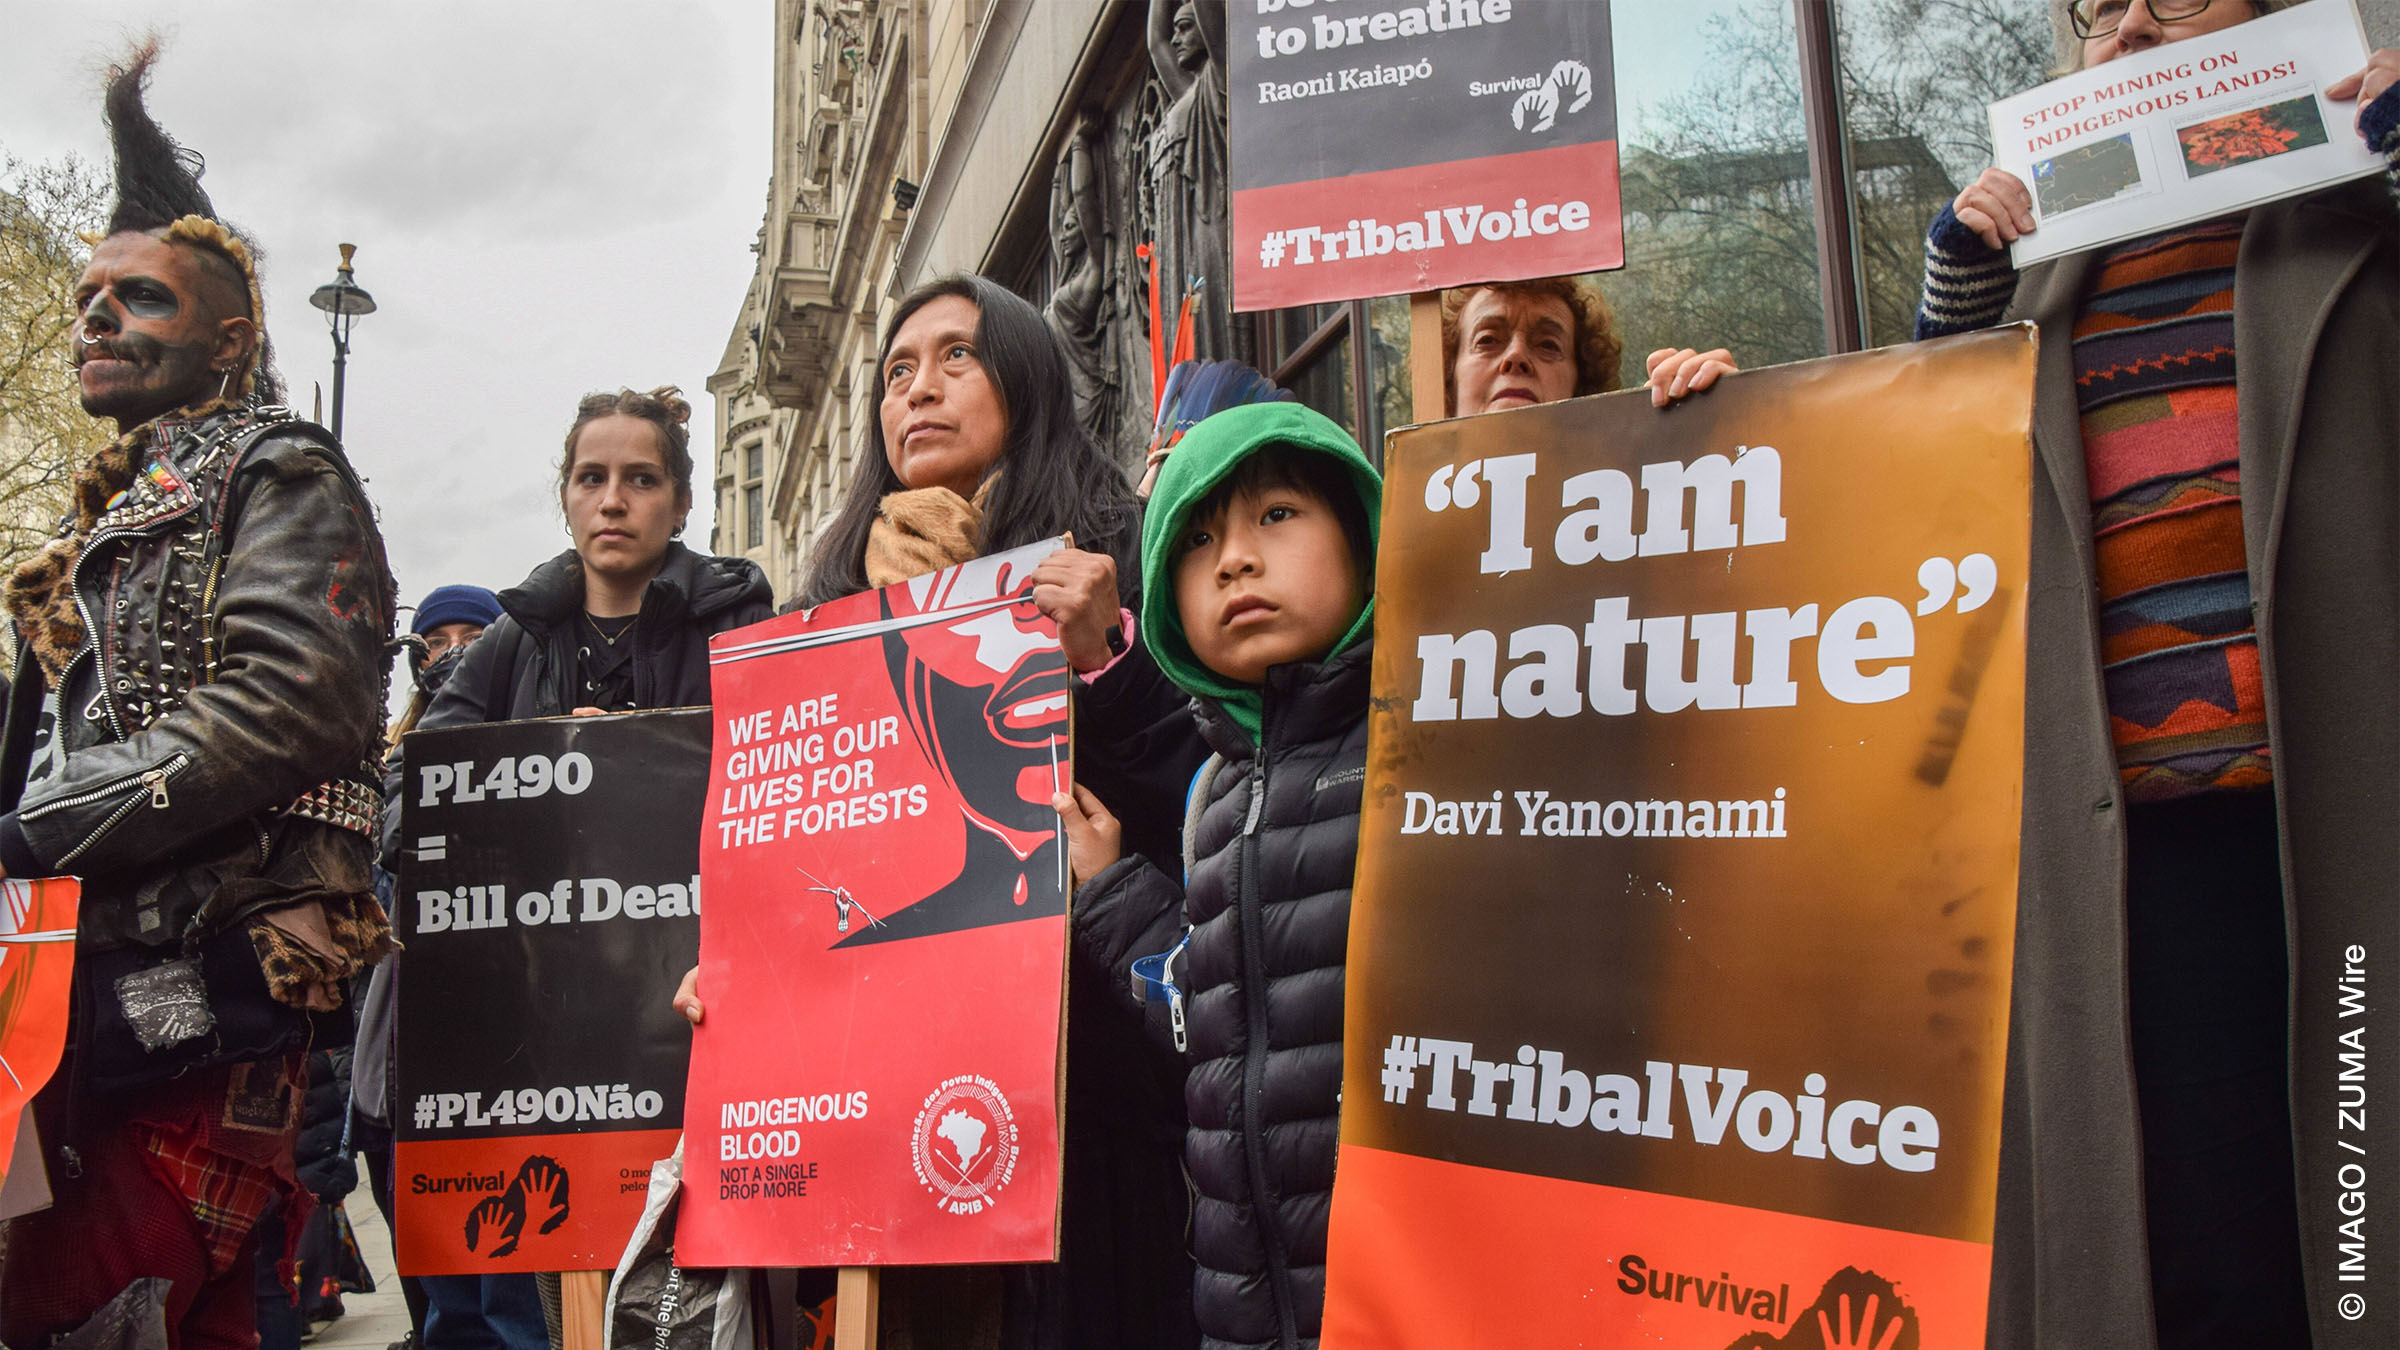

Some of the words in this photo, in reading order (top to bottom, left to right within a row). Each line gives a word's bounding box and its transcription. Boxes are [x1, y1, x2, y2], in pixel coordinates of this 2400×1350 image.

[1257, 26, 1306, 58] to
[1312, 0, 1511, 50] breathe
[1258, 72, 1334, 104] Raoni
[1338, 57, 1433, 92] Kaiapó
[1469, 73, 1542, 97] Survival
[2022, 95, 2086, 130] STOP
[2094, 63, 2192, 105] MINING
[2199, 50, 2240, 72] ON
[2027, 90, 2189, 153] INDIGENOUS
[2196, 60, 2297, 99] LANDS!
[1260, 198, 1590, 268] #TribalVoice
[1554, 445, 1787, 566] am
[1412, 553, 1998, 722] nature”
[728, 710, 772, 747] WE
[778, 693, 838, 736] ARE
[726, 733, 824, 781] GIVING
[833, 715, 899, 758] OUR
[419, 751, 593, 807] PL490
[721, 773, 804, 816] LIVES
[811, 758, 874, 799] FOR
[718, 812, 776, 850] THE
[783, 783, 928, 839] FORESTS
[1400, 790, 1503, 836] Davi
[1514, 787, 1788, 839] Yanomami
[417, 835, 446, 861] =
[416, 884, 508, 934] Bill
[516, 879, 572, 926] of
[579, 874, 701, 922] Deat
[923, 1088, 941, 1108] dos
[941, 1074, 973, 1090] Povos
[1381, 1034, 1941, 1173] #TribalVoice
[414, 1083, 663, 1129] #PL490Não
[721, 1090, 869, 1129] INDIGENOUS
[720, 1130, 801, 1161] BLOOD
[1009, 1124, 1018, 1142] do
[412, 1171, 504, 1194] Survival
[620, 1168, 629, 1178] O
[632, 1169, 650, 1178] mo
[720, 1167, 749, 1183] NOT
[752, 1166, 762, 1182] A
[765, 1162, 818, 1181] SINGLE
[1001, 1145, 1019, 1185] Brasil
[720, 1183, 760, 1200] DROP
[763, 1180, 807, 1198] MORE
[948, 1199, 983, 1215] APIB
[666, 1268, 680, 1290] ort
[1616, 1254, 1790, 1325] Survival
[658, 1294, 678, 1323] the
[655, 1327, 671, 1350] Bri
